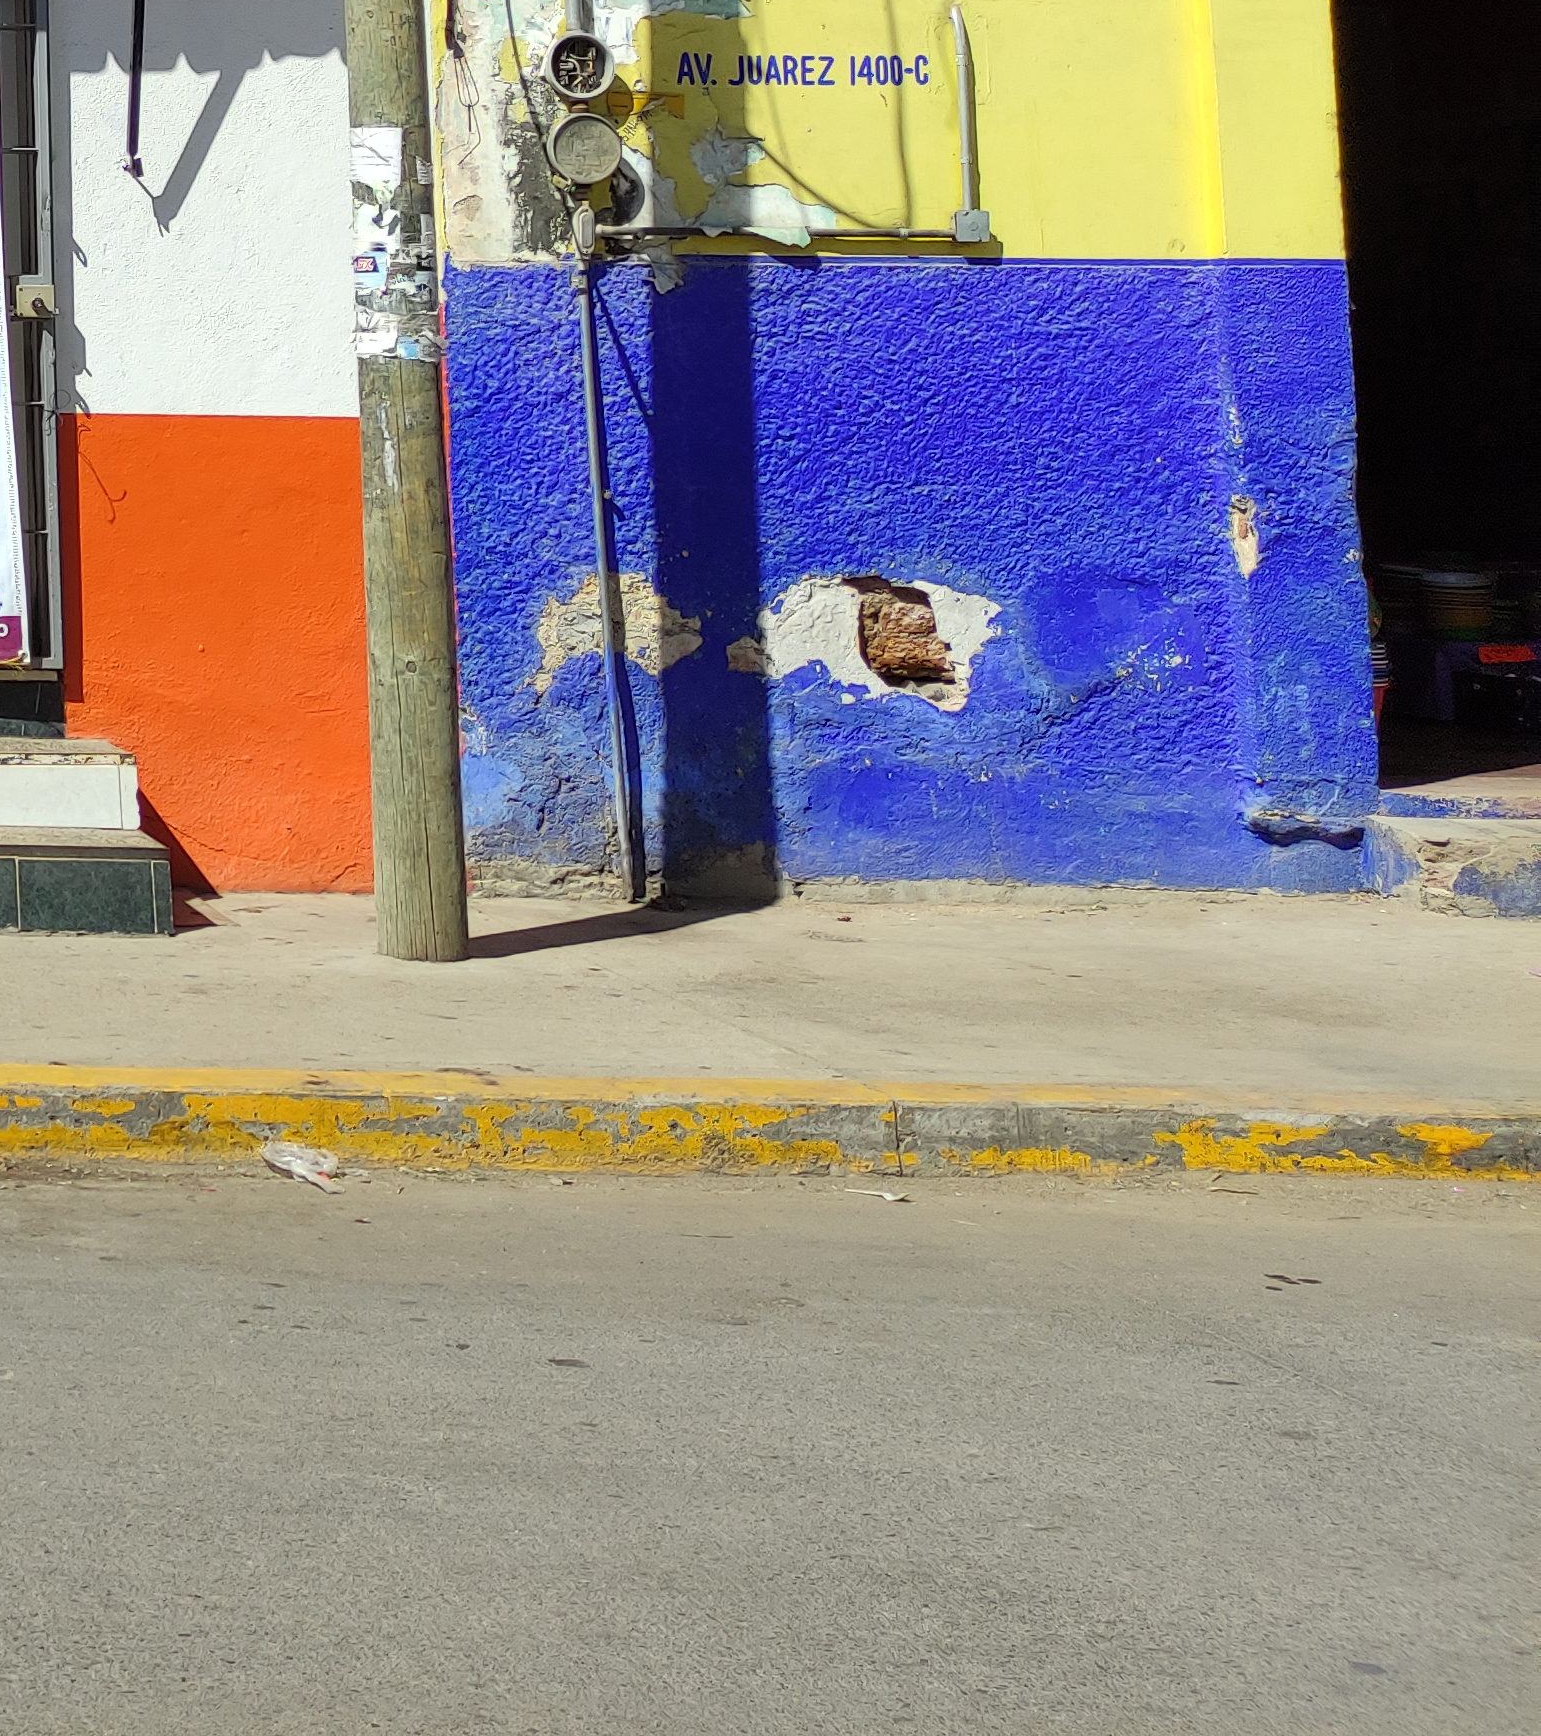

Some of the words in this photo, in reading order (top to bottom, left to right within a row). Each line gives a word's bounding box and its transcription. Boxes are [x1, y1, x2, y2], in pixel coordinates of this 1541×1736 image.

[677, 52, 717, 86] AV.
[728, 54, 835, 86] JUAREZ
[850, 54, 929, 86] 1400-C
